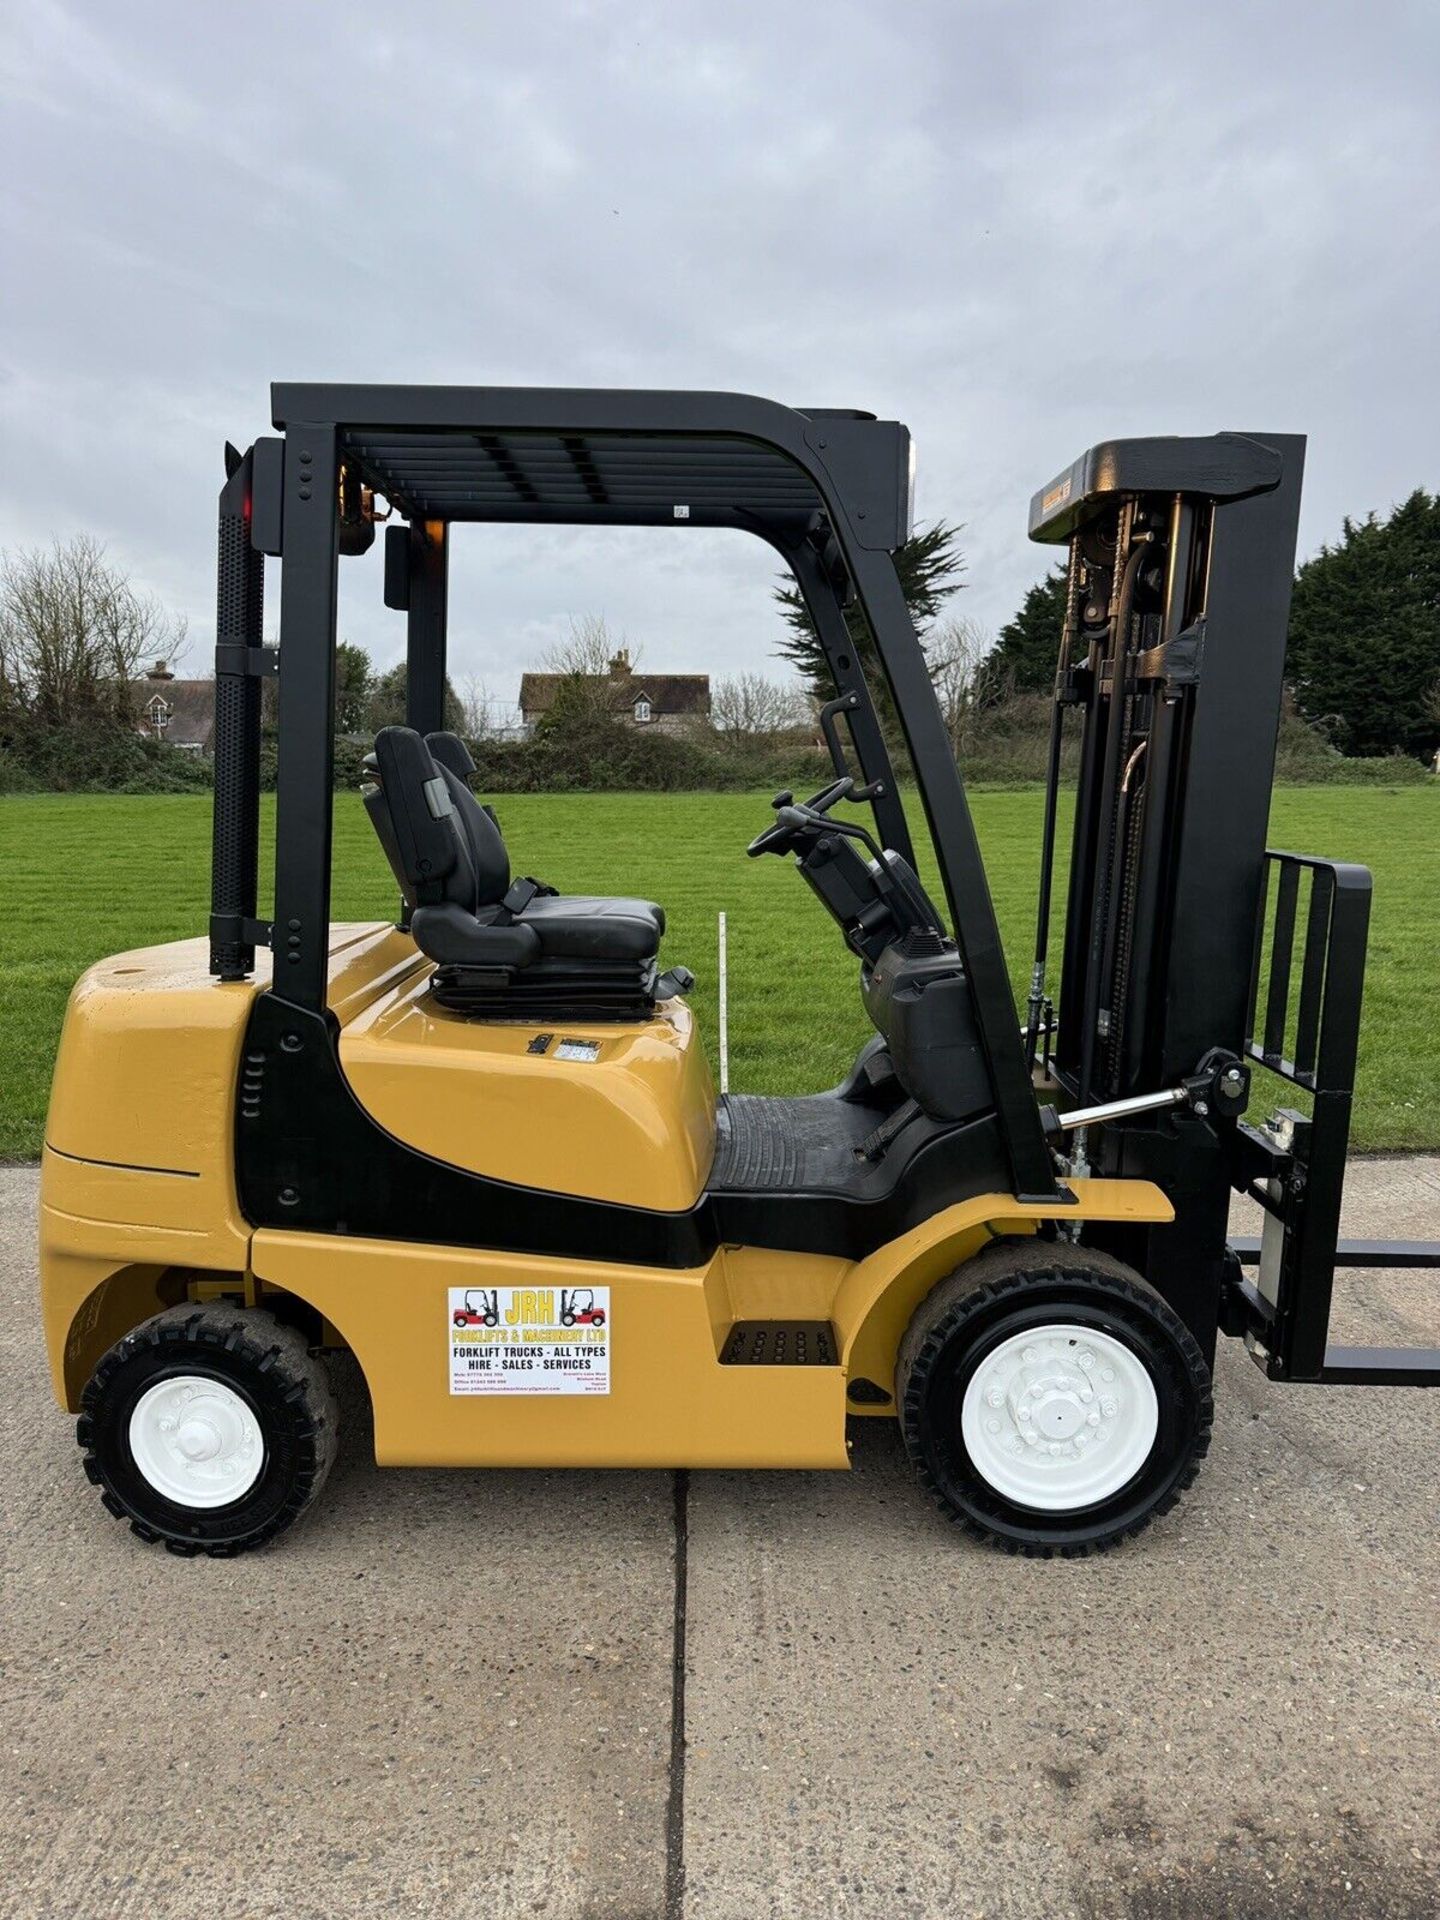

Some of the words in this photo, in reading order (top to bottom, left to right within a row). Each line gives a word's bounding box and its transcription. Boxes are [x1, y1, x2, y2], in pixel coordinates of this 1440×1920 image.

[504, 1290, 555, 1326] JRH
[453, 1347, 500, 1358] FORKLIFT
[504, 1347, 544, 1358] TRUCKS
[554, 1347, 572, 1357] ALL
[574, 1347, 606, 1357] TYPES
[468, 1359, 492, 1370] HIRE
[502, 1359, 533, 1370] SALES
[543, 1359, 592, 1370] SERVICES
